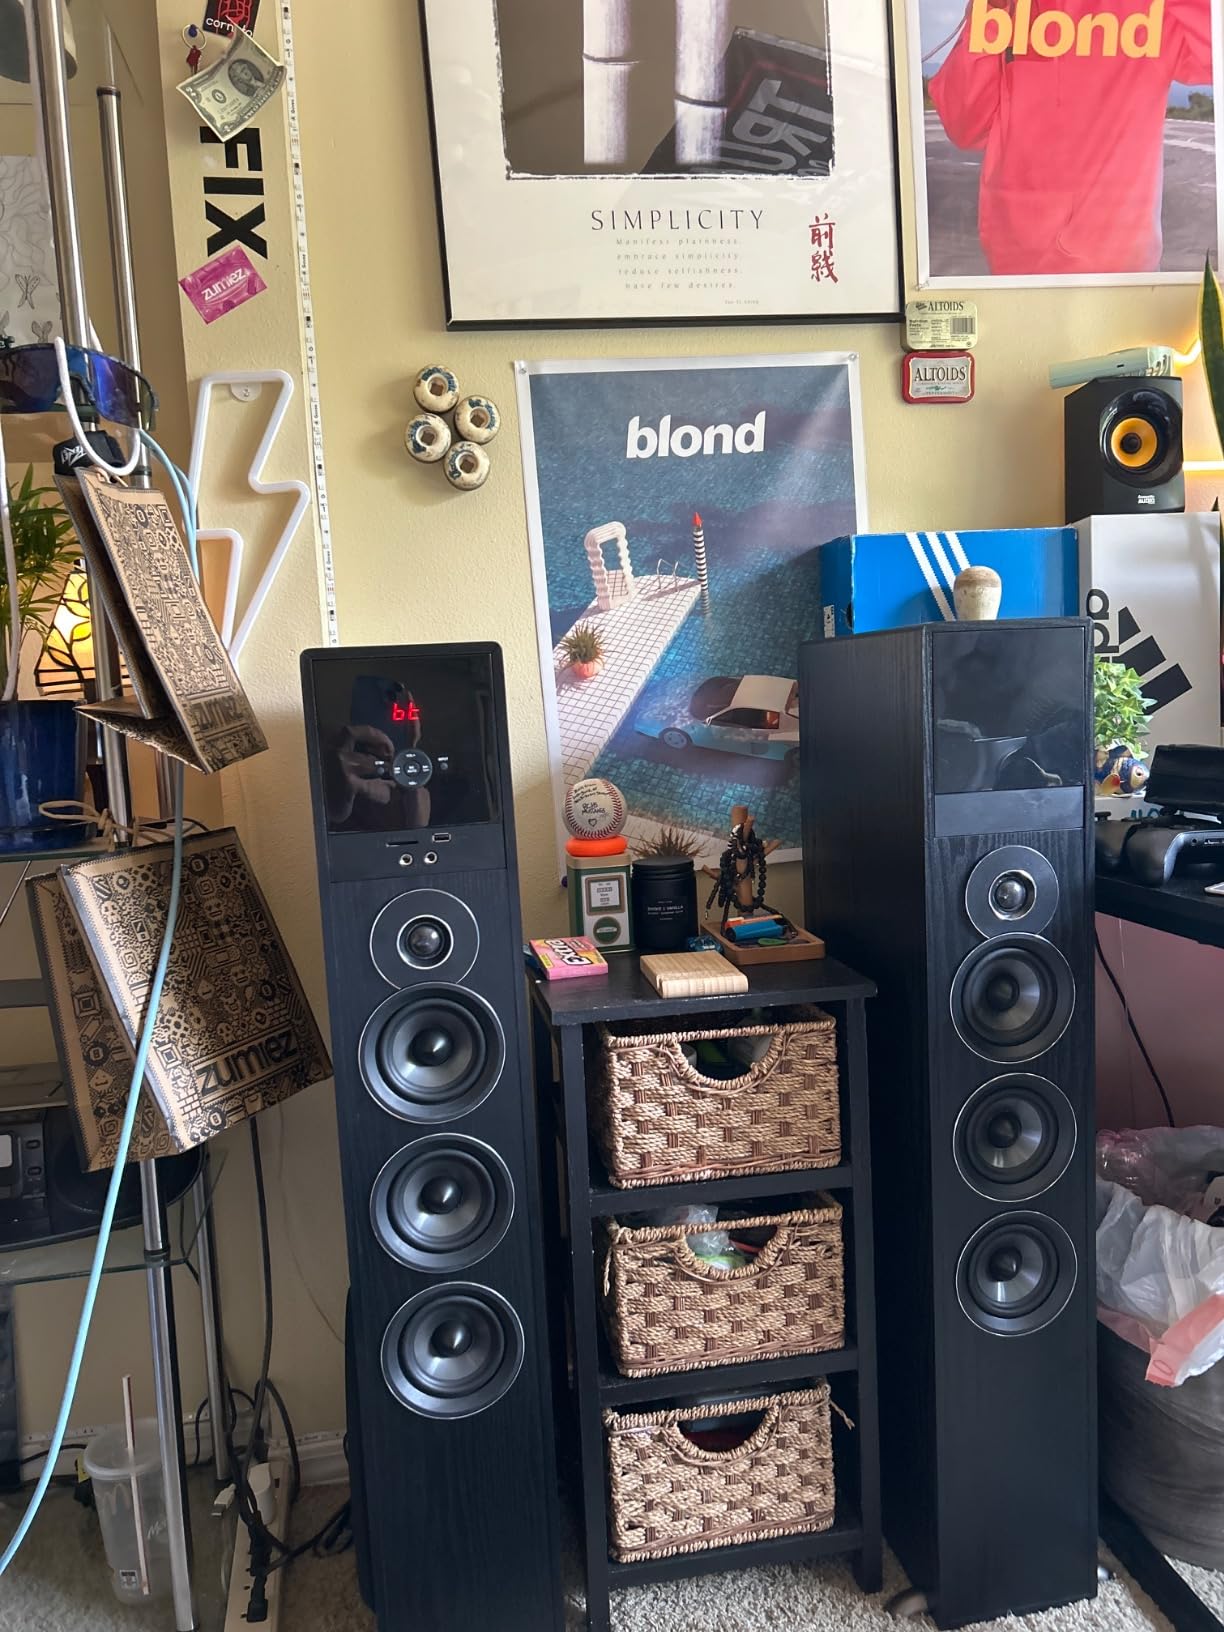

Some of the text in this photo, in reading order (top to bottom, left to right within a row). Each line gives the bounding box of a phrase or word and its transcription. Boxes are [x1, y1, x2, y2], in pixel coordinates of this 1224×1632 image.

[969, 0, 1165, 58] blond
[591, 209, 764, 231] SIMPLICITY
[201, 267, 248, 302] zumiez
[928, 301, 965, 311] ALTOIDS
[914, 366, 966, 382] ALTOIDS
[626, 410, 767, 459] blond
[196, 1029, 299, 1098] zumiez
